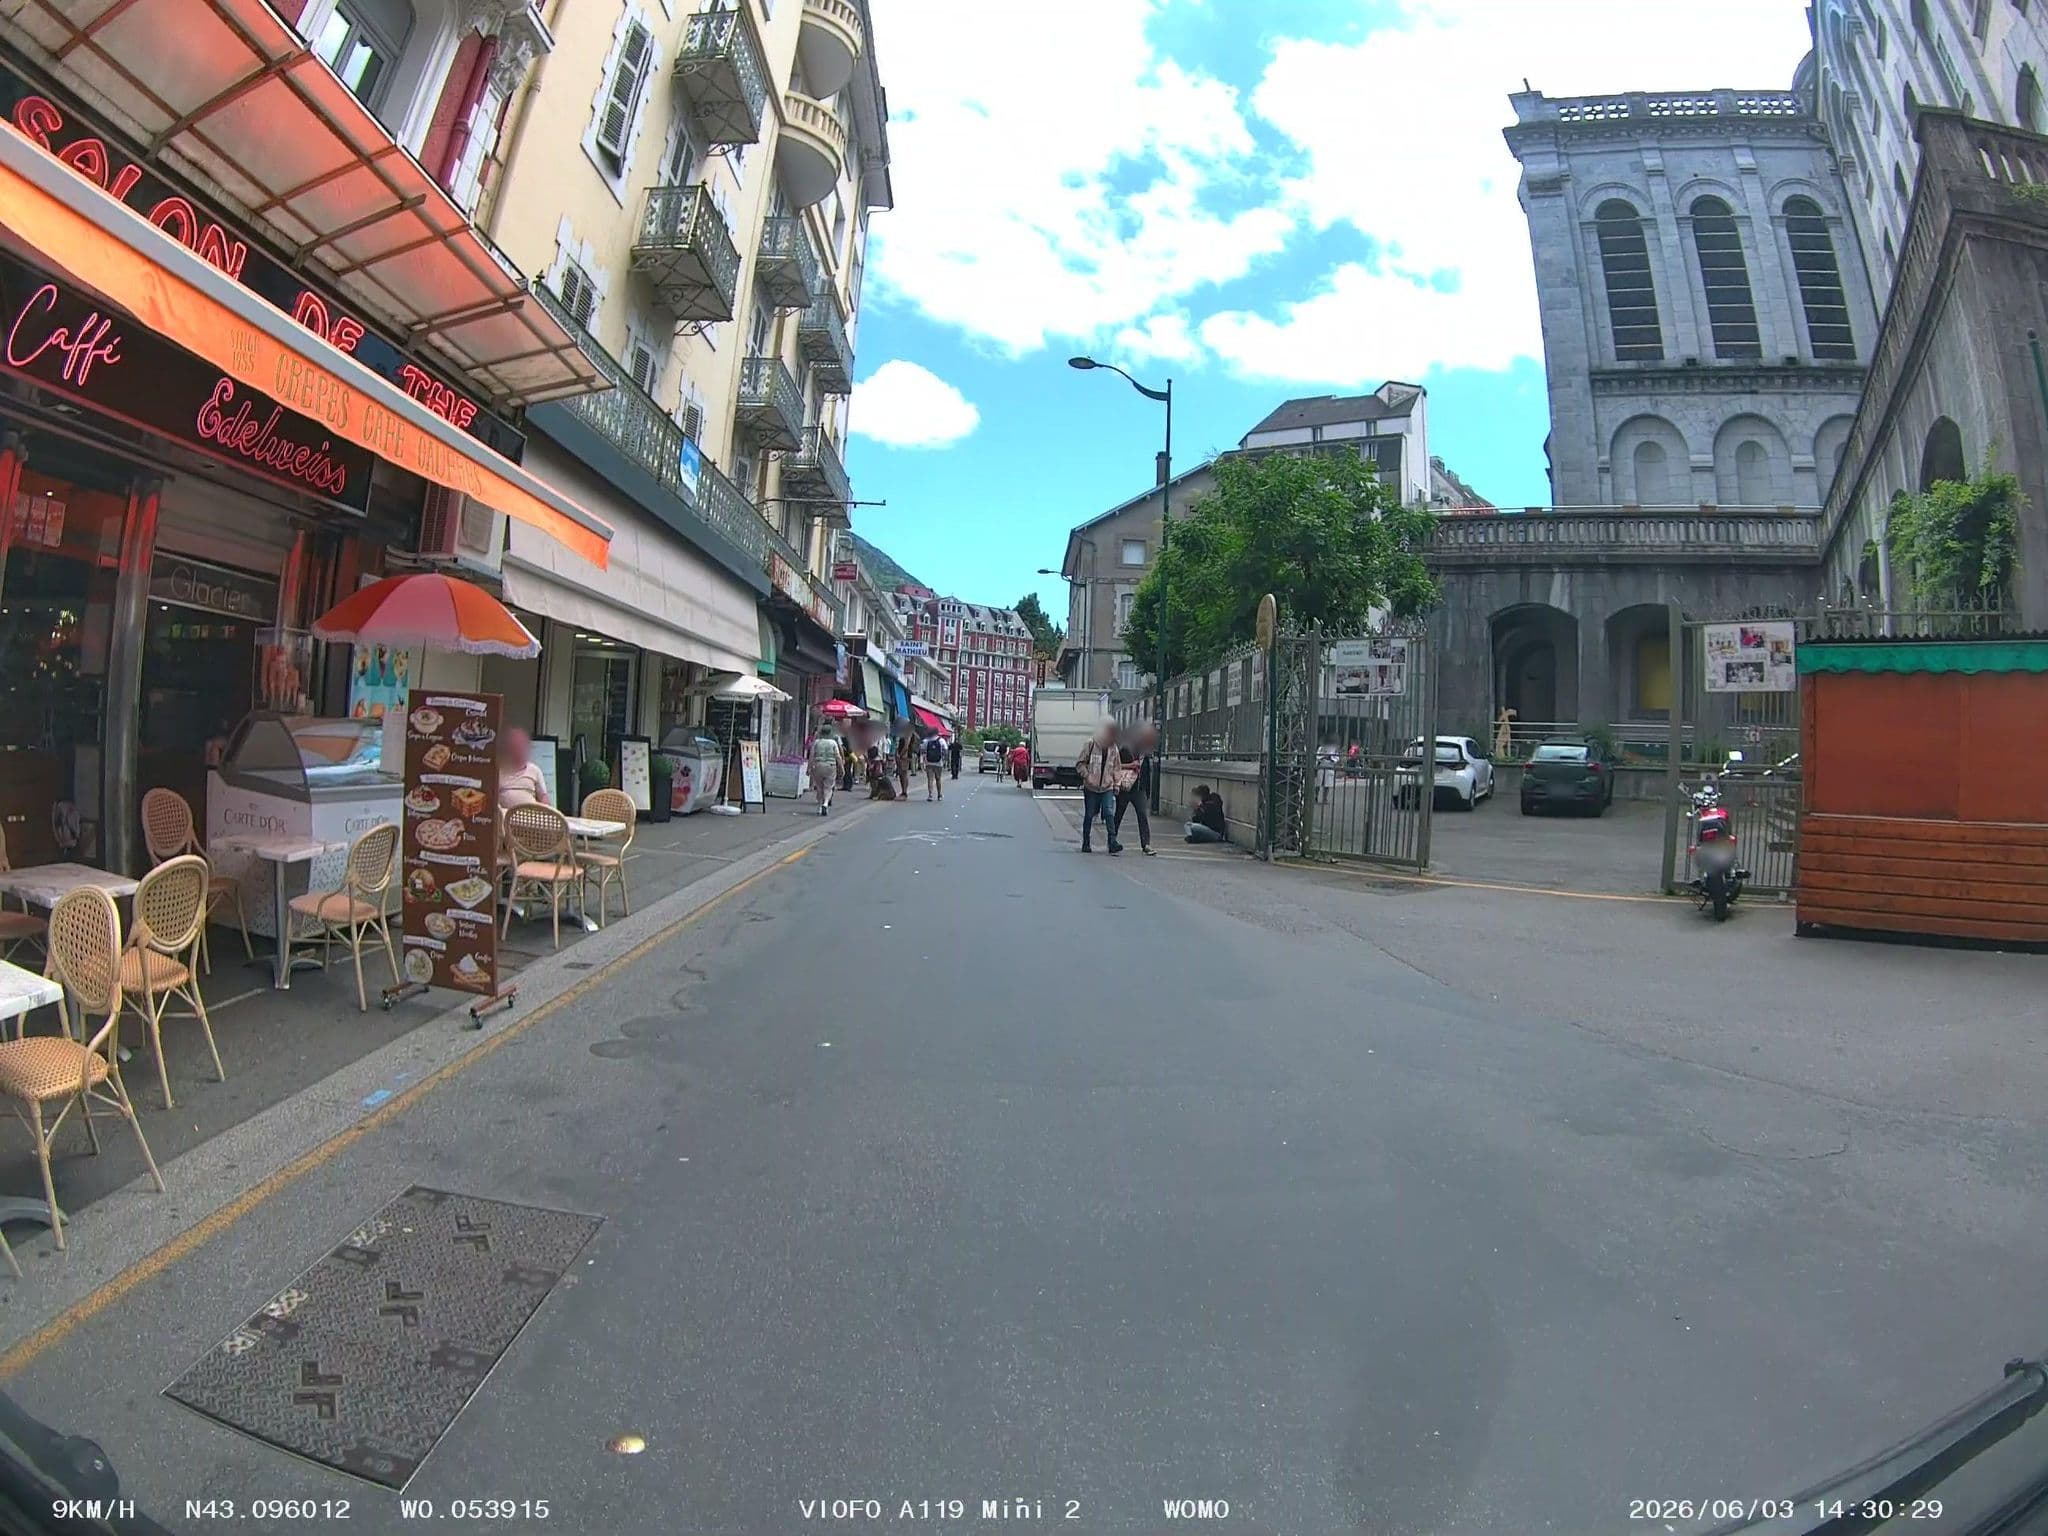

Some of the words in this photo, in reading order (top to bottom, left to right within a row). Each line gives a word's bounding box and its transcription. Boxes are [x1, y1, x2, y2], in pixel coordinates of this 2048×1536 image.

[7, 283, 122, 387] Caffé
[291, 291, 365, 352] DE
[196, 376, 347, 495] Edelweiss
[169, 564, 253, 613] Glacier
[894, 648, 928, 656] MATHIEU
[224, 808, 256, 827] CARTE
